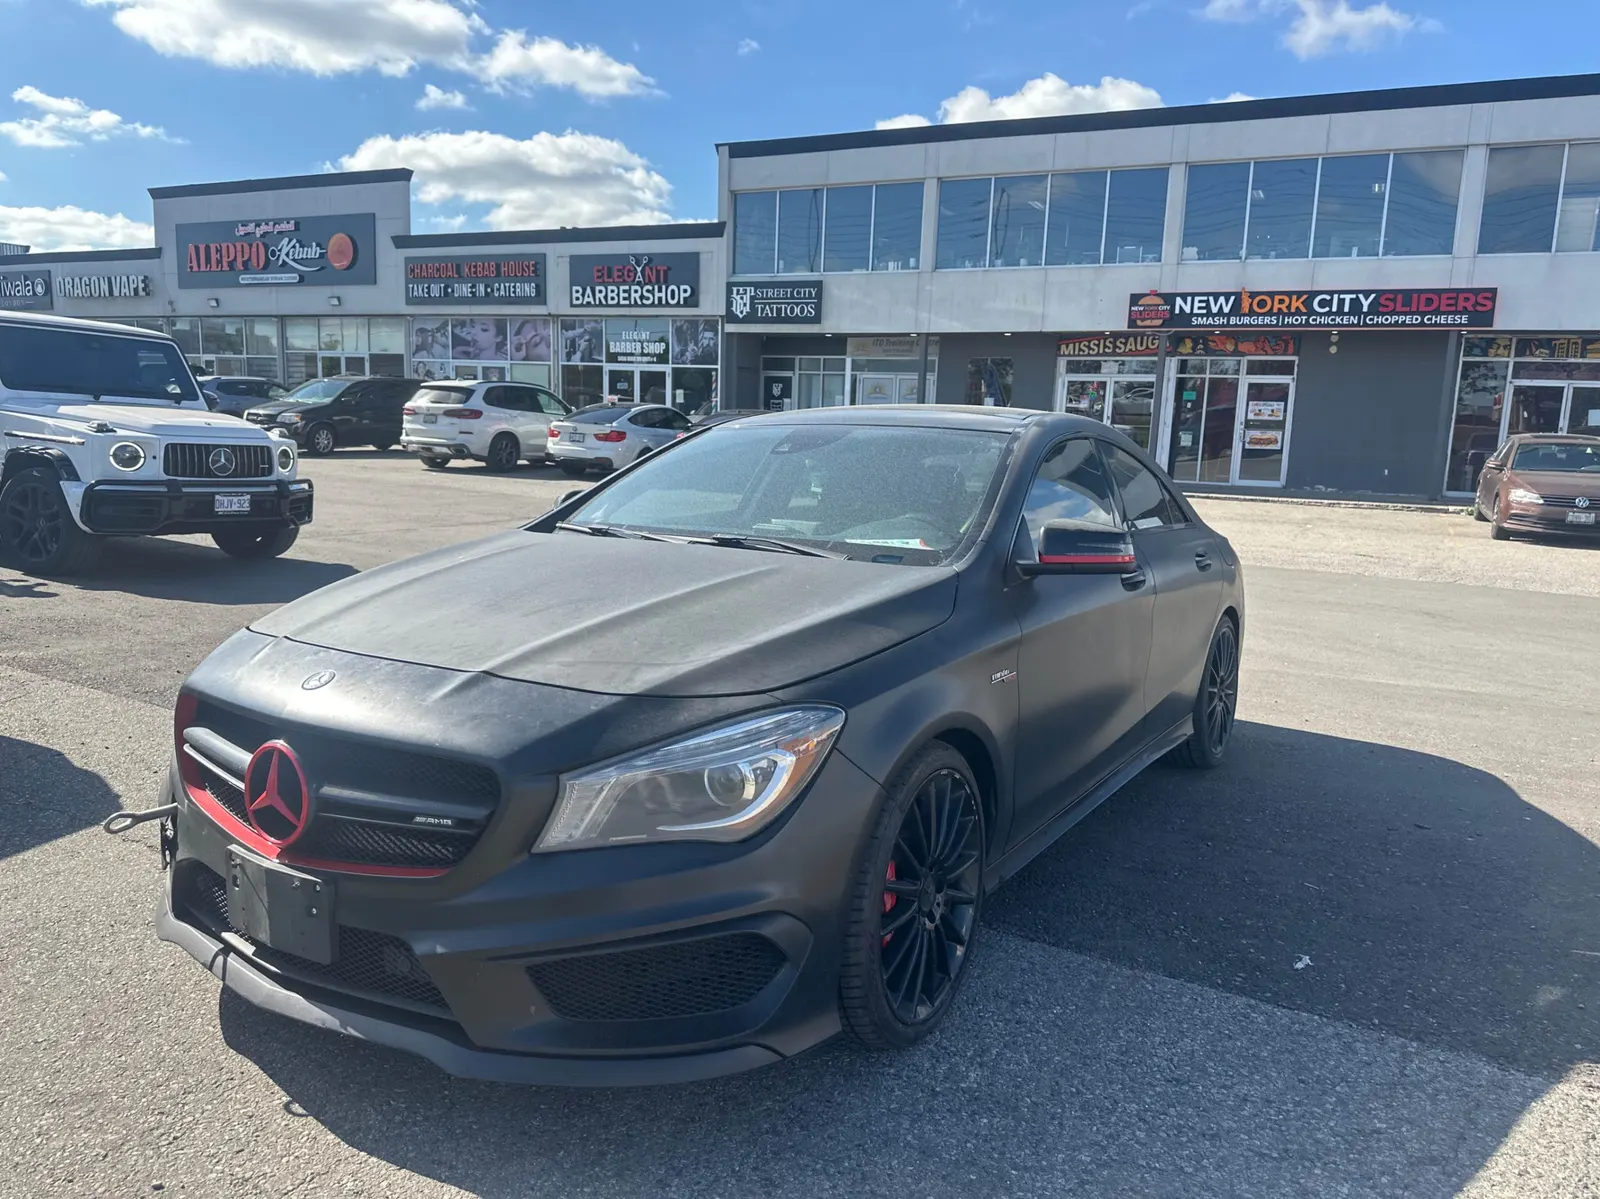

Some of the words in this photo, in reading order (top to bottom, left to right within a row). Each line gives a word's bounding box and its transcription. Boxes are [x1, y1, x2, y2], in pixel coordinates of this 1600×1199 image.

[187, 240, 266, 272] ALEPPO
[408, 263, 458, 278] CHARCOAL
[464, 262, 496, 277] KEBAB
[501, 261, 536, 276] HOUSE
[56, 275, 110, 298] DRAGON
[111, 275, 146, 297] VAPE
[408, 284, 428, 298] TAKE
[430, 284, 445, 297] OUT
[454, 283, 485, 297] DINE-IN
[493, 282, 536, 297] CATERING
[572, 285, 691, 305] BARBERSHOP
[756, 288, 792, 298] STREET
[794, 288, 818, 298] CITY
[755, 304, 815, 317] TATTOOS
[1174, 295, 1236, 314] NEW
[1312, 293, 1377, 313] CITY
[1378, 292, 1494, 313] SLIDERS
[1191, 316, 1227, 325] SMASH
[1229, 316, 1277, 325] BURGERS
[1284, 315, 1307, 325] HOT
[1309, 315, 1358, 325] CHICKEN
[1366, 314, 1421, 324] CHOPPED
[1423, 314, 1469, 324] CHEESE
[609, 341, 642, 353] BARBER
[643, 342, 666, 354] SHOP
[1060, 335, 1170, 356] MISSISSAUG
